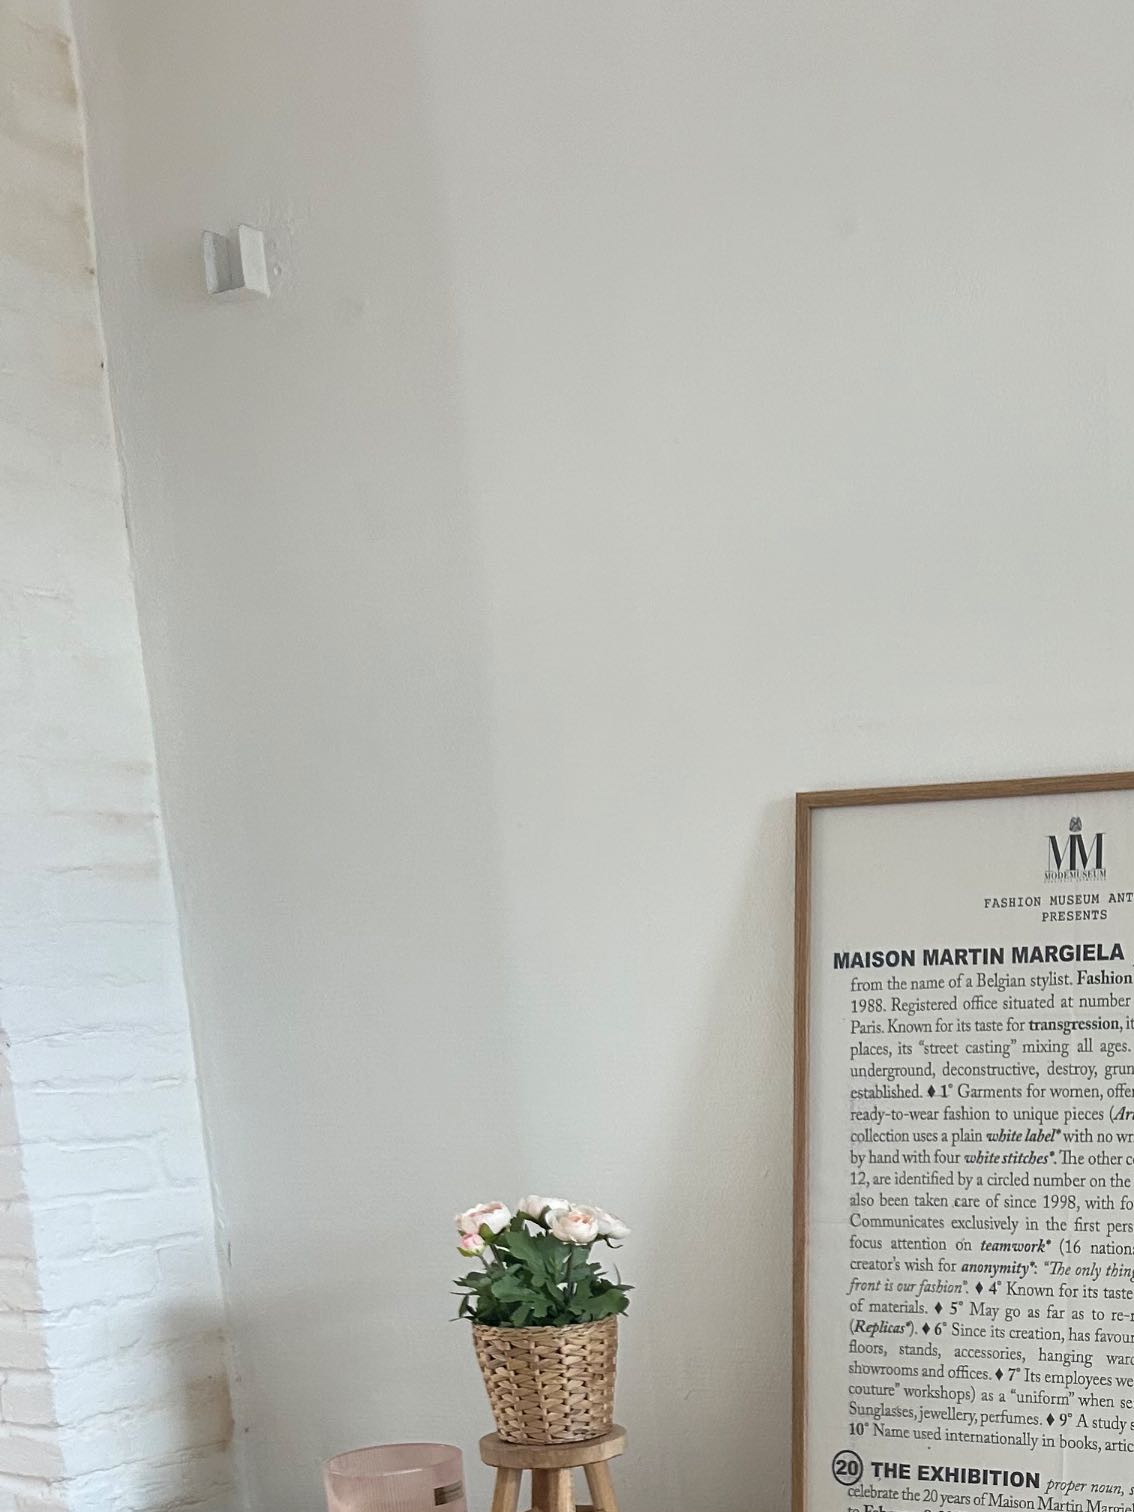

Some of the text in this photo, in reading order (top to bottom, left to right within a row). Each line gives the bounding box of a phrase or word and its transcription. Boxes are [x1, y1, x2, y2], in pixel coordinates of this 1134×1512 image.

[983, 896, 1041, 908] FASHION
[1049, 894, 1099, 906] MUSEUM
[1041, 909, 1107, 922] PRESENTS
[833, 950, 915, 969] MAISON
[922, 946, 1004, 966] MARTIN
[1011, 942, 1125, 963] MARGIELA
[850, 976, 883, 991] from
[887, 975, 907, 990] the
[910, 979, 945, 989] name
[948, 973, 964, 988] of
[965, 978, 973, 987] a
[976, 971, 1026, 991] Belgian
[1030, 970, 1073, 990] stylist.
[1076, 968, 1133, 985] Fashion
[851, 998, 886, 1013] 1988.
[890, 995, 958, 1015] Registered
[962, 994, 998, 1010] office
[1002, 993, 1055, 1009] situated
[1060, 996, 1074, 1008] at
[1079, 992, 1131, 1007] number
[849, 1041, 892, 1059] places,
[897, 1041, 912, 1054] its
[1022, 1039, 1069, 1057] mixing
[1076, 1037, 1093, 1052] all
[1099, 1042, 1131, 1056] ages.
[849, 1061, 936, 1081] underground,
[942, 1060, 1040, 1079] deconstructive,
[1046, 1059, 1098, 1079] destroy,
[850, 1105, 940, 1123] ready-to-wear
[943, 1105, 990, 1120] fashion
[995, 1109, 1008, 1120] to
[1012, 1106, 1059, 1123] unique
[1063, 1107, 1104, 1123] pieces
[849, 1192, 874, 1206] also
[879, 1192, 909, 1206] been
[914, 1192, 948, 1207] taken
[951, 1197, 980, 1208] care
[985, 1193, 1000, 1207] of
[1003, 1194, 1036, 1208] since
[1042, 1194, 1080, 1212] 1998,
[1084, 1194, 1115, 1209] with
[849, 1213, 945, 1228] Communicates
[950, 1214, 1019, 1234] exclusively
[1025, 1217, 1039, 1230] in
[1044, 1216, 1067, 1231] the
[1073, 1216, 1100, 1232] first
[849, 1234, 882, 1249] focus
[890, 1236, 947, 1250] attention
[955, 1238, 972, 1250] on
[1059, 1238, 1081, 1256] (16
[848, 1339, 887, 1356] floors,
[898, 1340, 941, 1359] stands,
[953, 1345, 1026, 1363] accessories,
[1038, 1347, 1093, 1367] hanging
[903, 1382, 976, 1404] workshops)
[980, 1392, 993, 1401] as
[998, 1393, 1006, 1402] a
[1077, 1391, 1115, 1407] when
[872, 1422, 910, 1438] Name
[912, 1425, 942, 1440] used
[944, 1427, 1039, 1450] internationally
[1041, 1434, 1056, 1447] in
[1058, 1434, 1102, 1453] books,
[836, 1460, 859, 1477] 20
[870, 1461, 911, 1479] THE
[917, 1465, 1040, 1488] EXHIBITION
[1045, 1479, 1087, 1495] proper
[1090, 1484, 1124, 1496] noun,
[848, 1484, 899, 1500] celebrate
[901, 1486, 920, 1501] the
[922, 1488, 938, 1502] 20
[940, 1494, 971, 1507] years
[973, 1491, 988, 1506] of
[987, 1492, 1035, 1509] Maison
[1037, 1496, 1083, 1512] Martin
